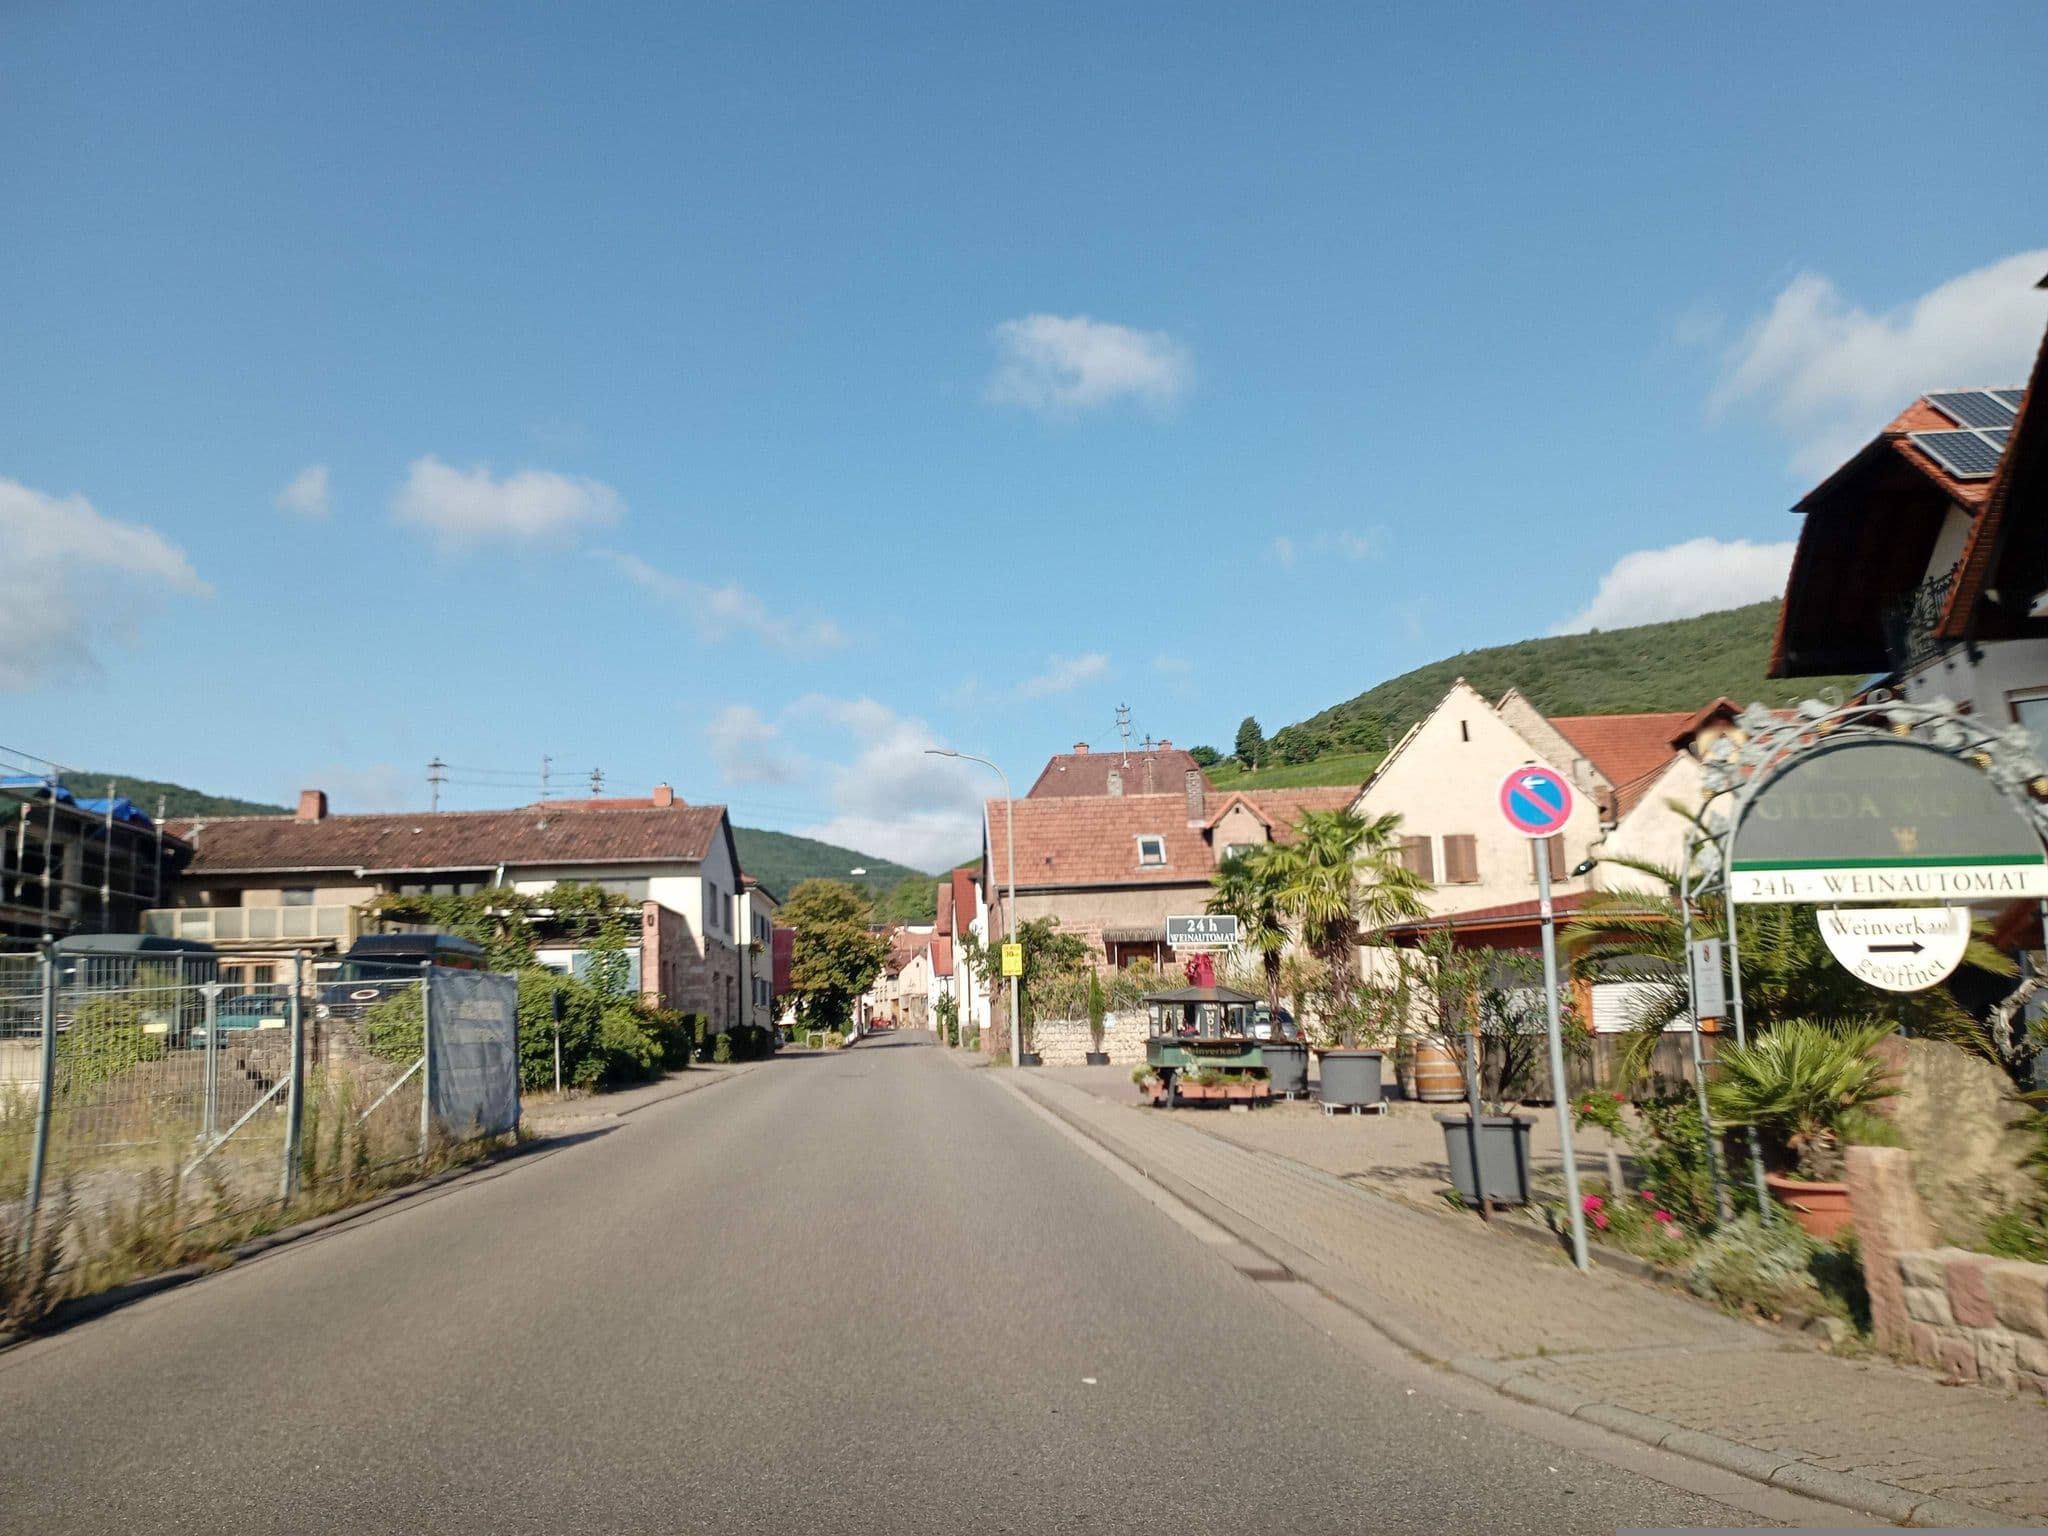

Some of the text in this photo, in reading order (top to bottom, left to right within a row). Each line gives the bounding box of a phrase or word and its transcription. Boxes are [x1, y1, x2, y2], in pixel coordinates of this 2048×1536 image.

[1823, 871, 2029, 893] WEINAUTOMAT
[1187, 918, 1218, 932] 24 h
[1170, 932, 1235, 942] WEINAUTOMAT
